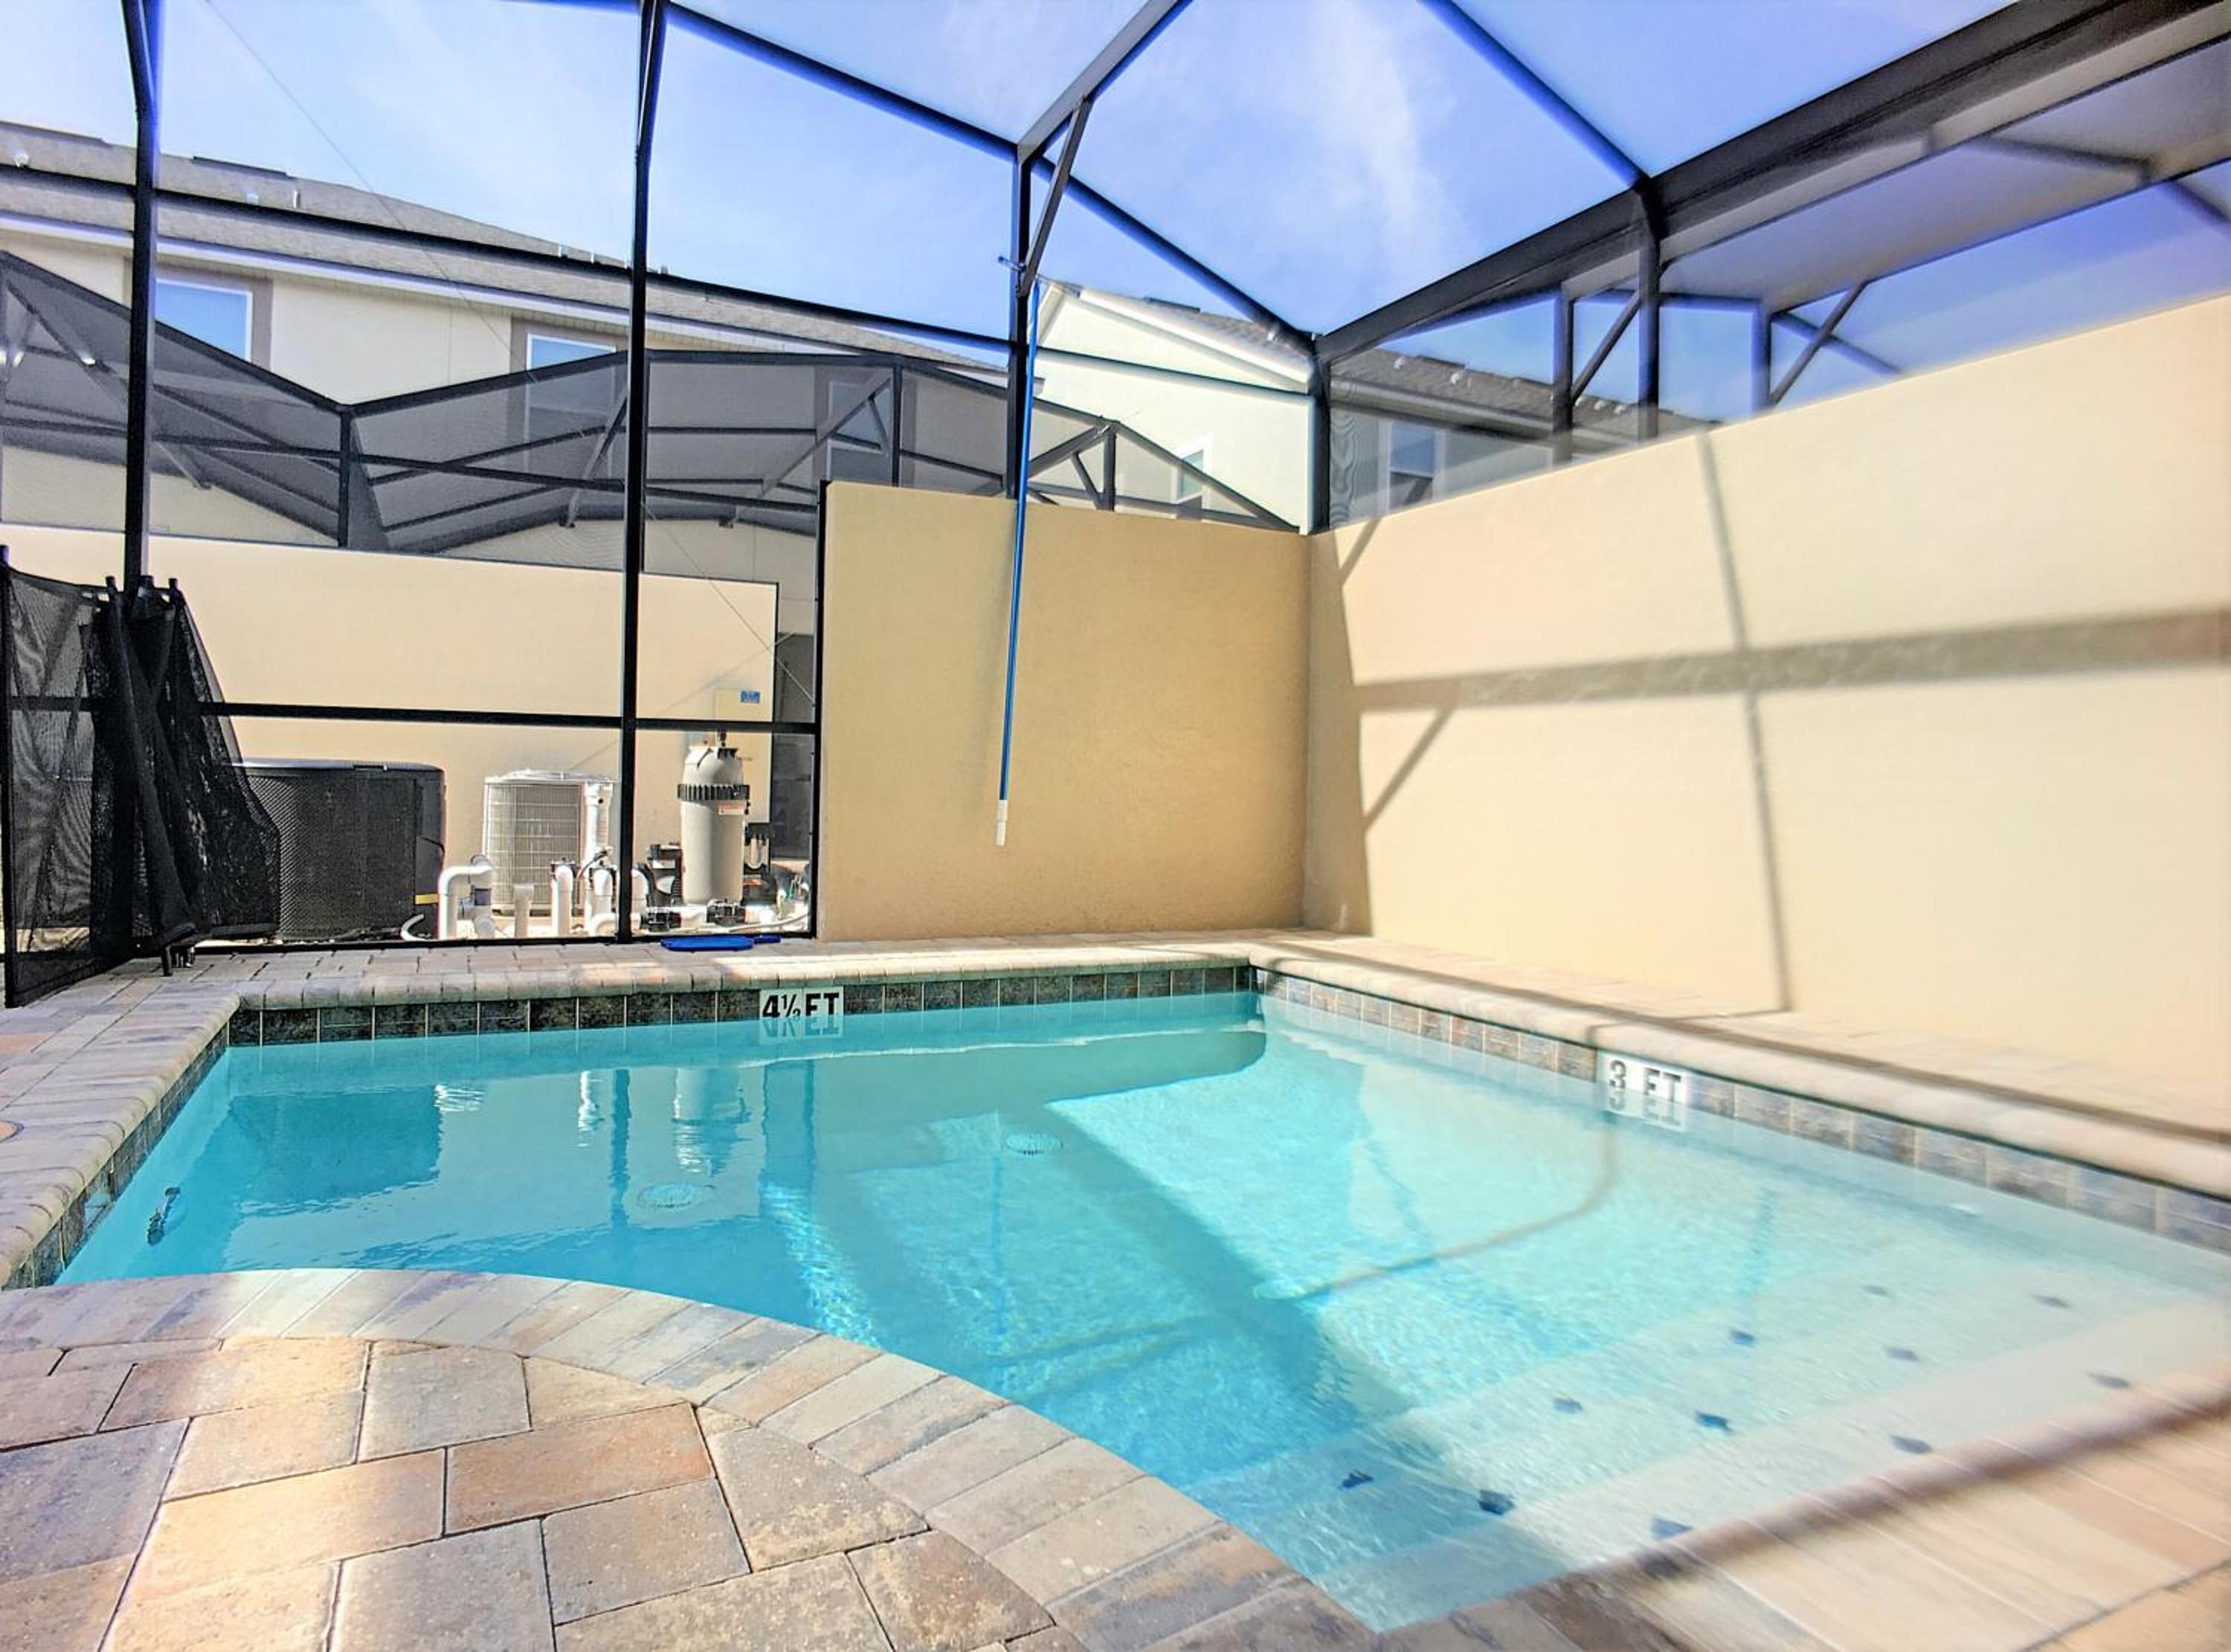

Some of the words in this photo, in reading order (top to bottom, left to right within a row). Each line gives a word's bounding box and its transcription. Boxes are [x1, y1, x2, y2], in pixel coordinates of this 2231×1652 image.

[805, 993, 840, 1016] FT
[1609, 1060, 1626, 1089] 3
[1644, 1067, 1681, 1100] FT
